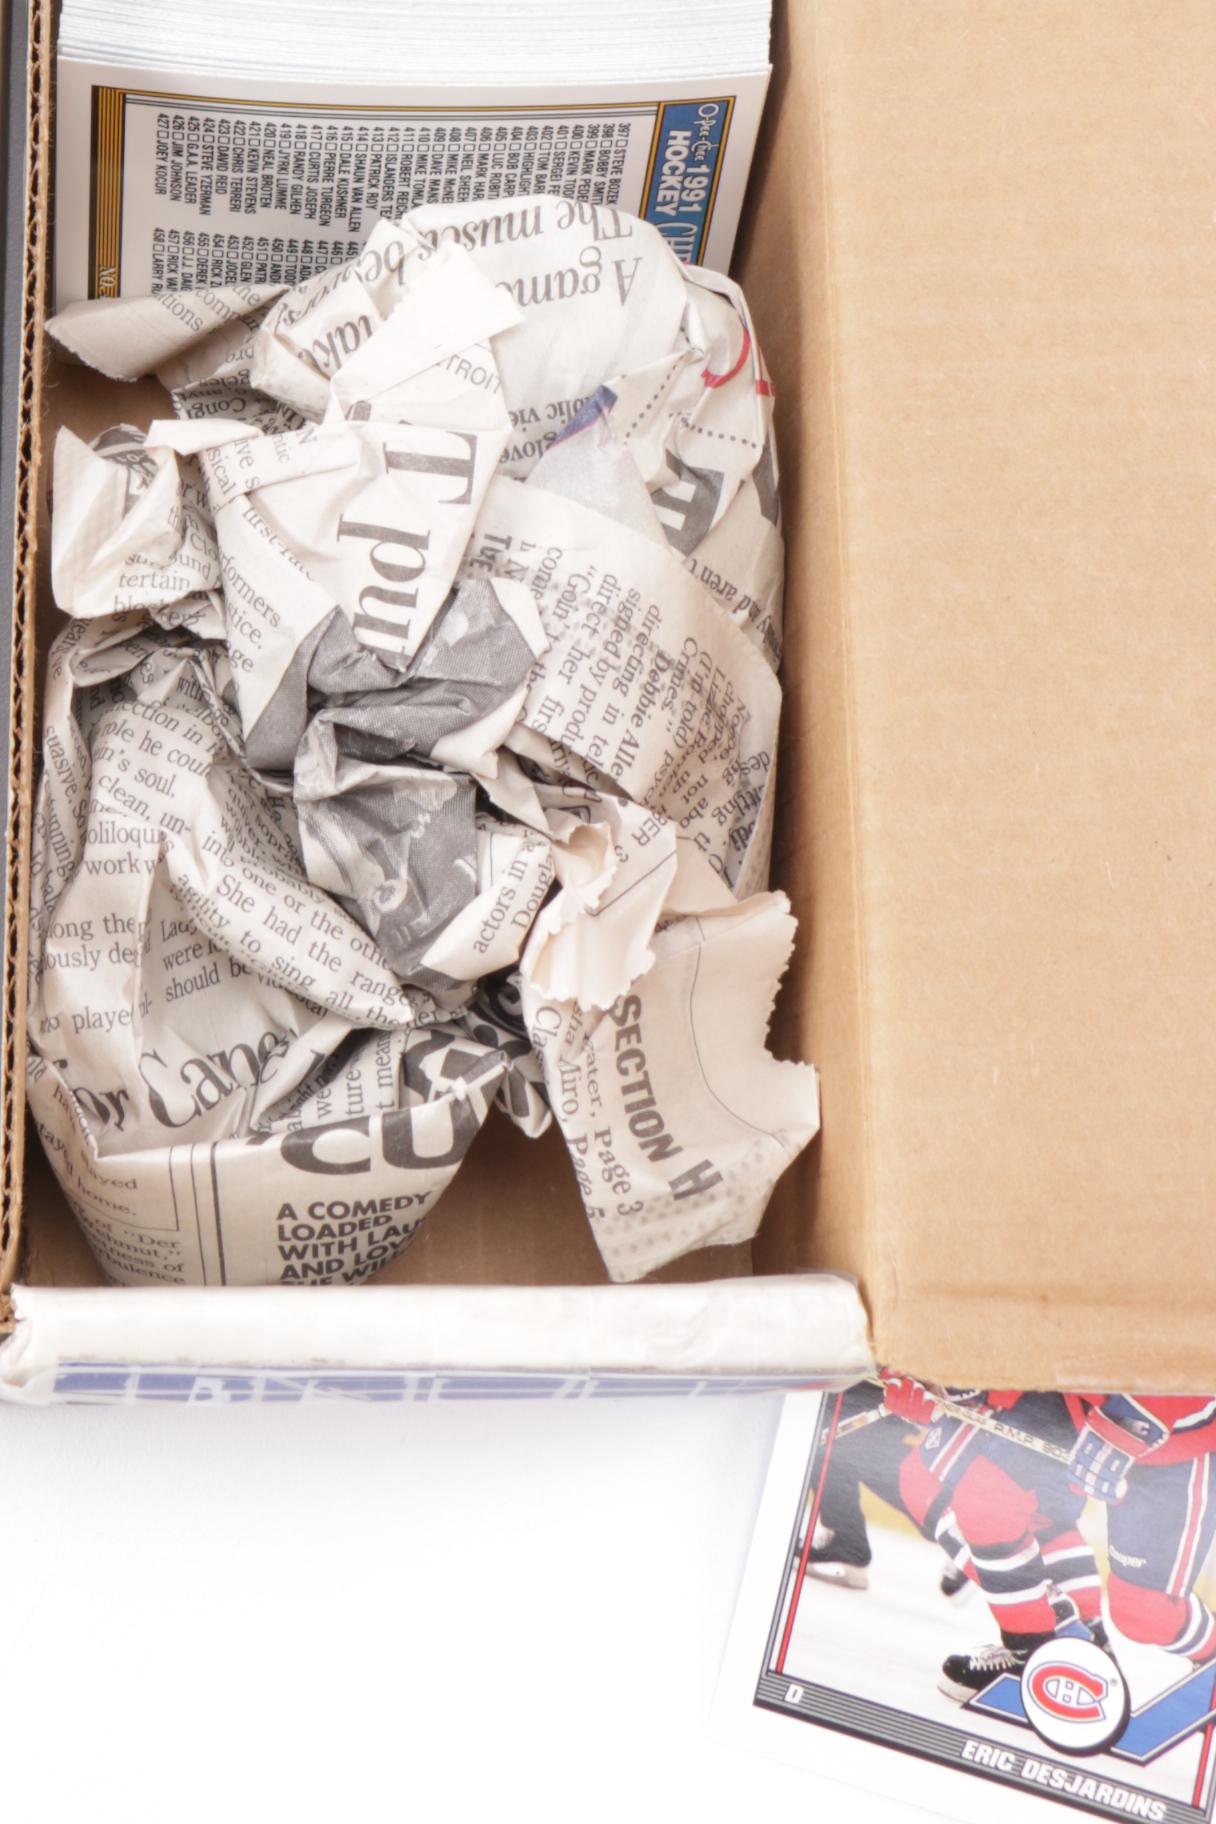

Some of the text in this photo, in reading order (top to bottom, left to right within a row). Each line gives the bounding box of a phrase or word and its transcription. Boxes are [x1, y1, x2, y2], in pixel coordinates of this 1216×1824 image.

[155, 113, 169, 195] 427 JOEY KOCUR
[199, 117, 215, 215] 424 STEVE YZERMAN
[245, 121, 261, 214] 421 KEVIN STEVENS
[290, 124, 308, 215] 418 RANDY GILHEN
[304, 125, 323, 219] 417 CURTIS JOSEPH
[319, 126, 338, 227] 416 PIERRE TURGEON
[349, 127, 369, 232] 414 SHAUN VAN ALLEN
[366, 127, 384, 210] 413 PATRICK ROY
[655, 131, 692, 216] HOCKEY
[679, 167, 710, 213] 1991
[557, 199, 633, 242] The
[612, 257, 643, 307] A
[581, 574, 618, 638] direct
[603, 588, 641, 656] signed
[558, 644, 593, 684] her
[593, 658, 614, 687] by
[602, 604, 661, 726] directing in
[630, 649, 673, 728] Debbie
[138, 729, 164, 758] he
[98, 774, 192, 836] clean, un-
[85, 850, 140, 877] work
[216, 874, 343, 973] She had the
[242, 866, 277, 896] one
[284, 893, 307, 914] or
[310, 908, 344, 943] the
[473, 858, 528, 954] actors in
[162, 946, 204, 972] were
[164, 962, 221, 1003] should
[238, 927, 262, 954] to
[271, 956, 316, 990] sing
[325, 990, 353, 1012] all
[607, 994, 724, 1201] SECTION H
[276, 1190, 433, 1221] A COMEDY
[593, 1126, 644, 1216] Page 3
[278, 1214, 392, 1242] LOADED
[278, 1238, 358, 1261] WITH
[280, 1258, 345, 1280] AND
[785, 1684, 1166, 1821] D ERIC DESJARDINS
